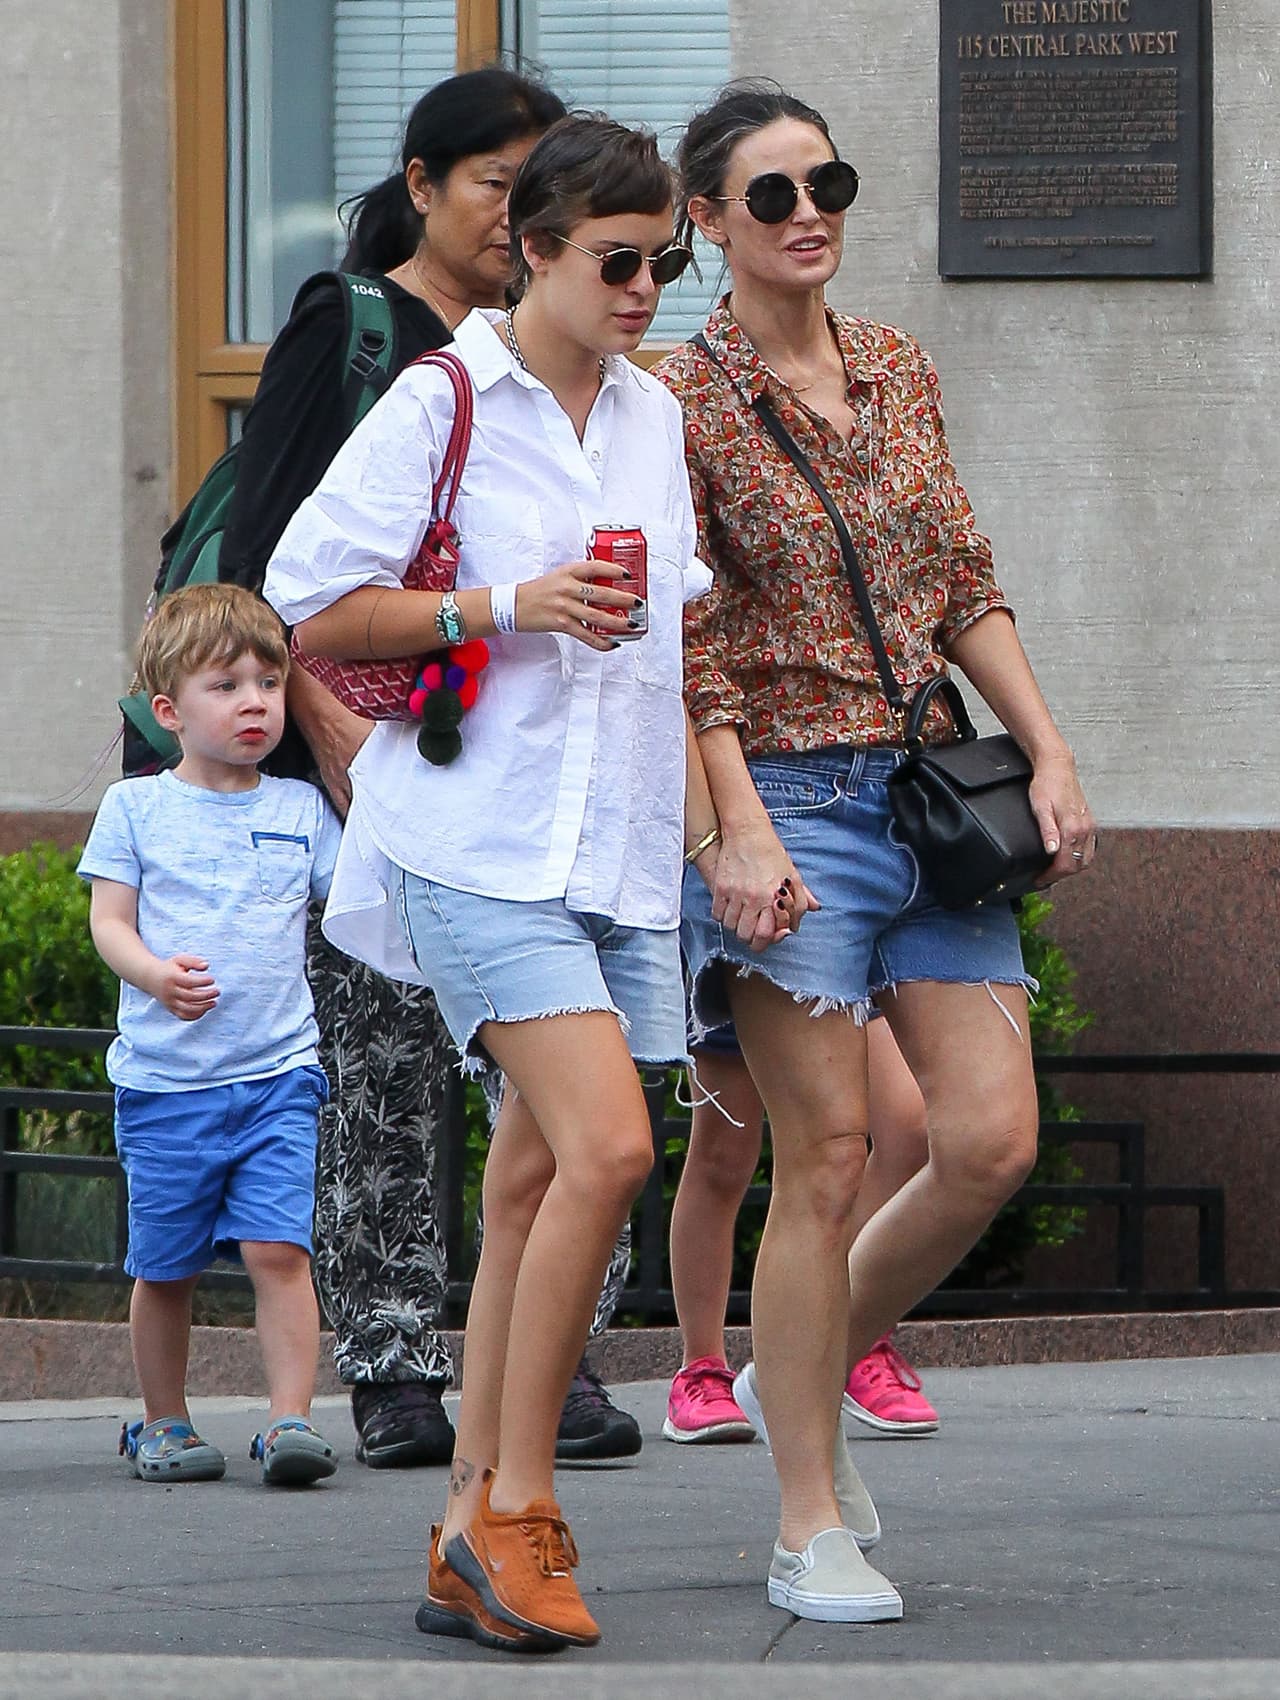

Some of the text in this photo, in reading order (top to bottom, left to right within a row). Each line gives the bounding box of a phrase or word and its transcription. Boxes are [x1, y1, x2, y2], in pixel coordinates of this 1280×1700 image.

[1002, 0, 1129, 24] THE MAJESTIC
[957, 30, 1178, 59] 115 CENTRAL PARK WEST
[351, 284, 385, 299] 1042
